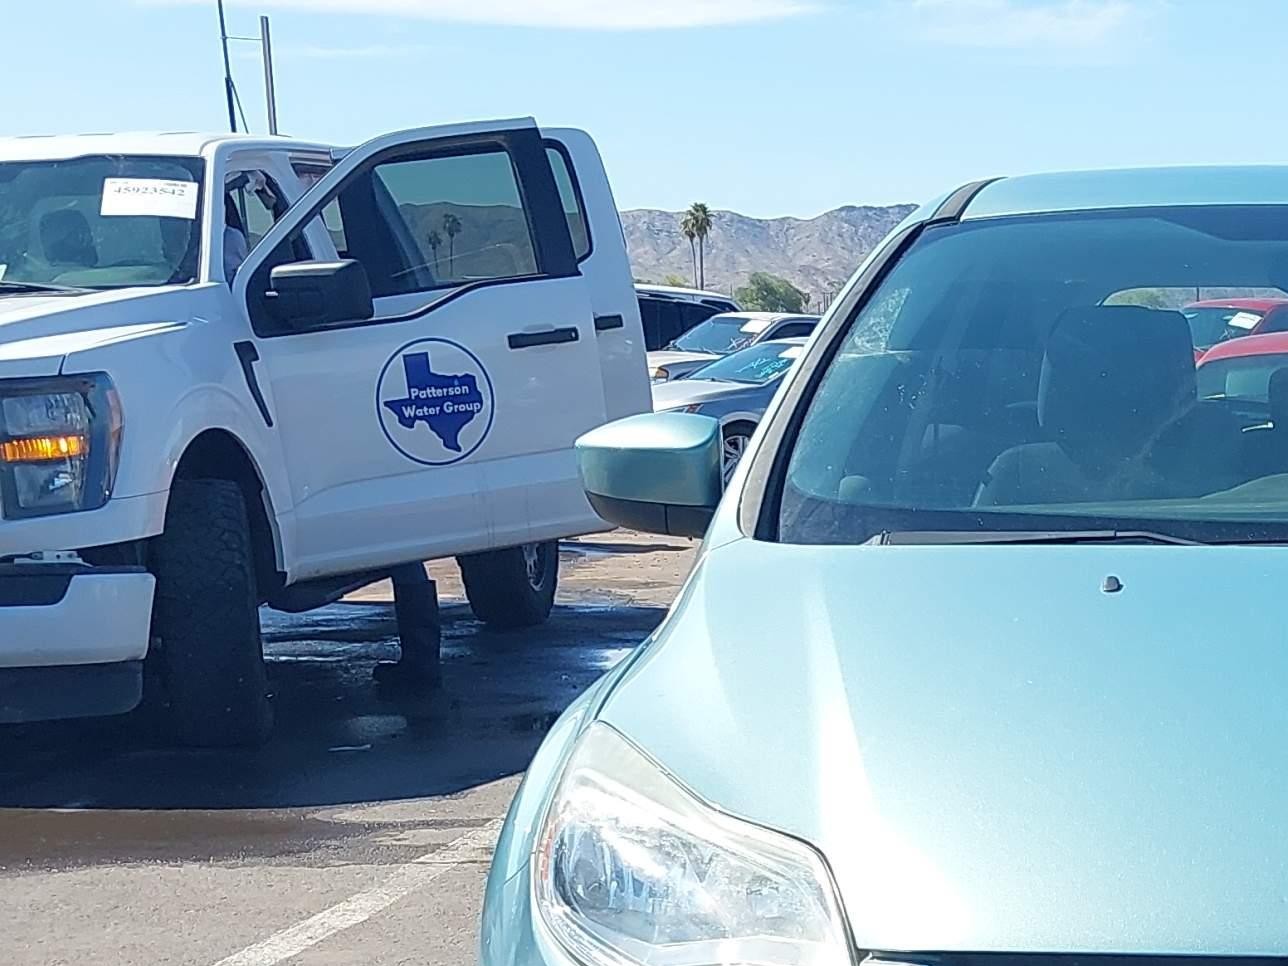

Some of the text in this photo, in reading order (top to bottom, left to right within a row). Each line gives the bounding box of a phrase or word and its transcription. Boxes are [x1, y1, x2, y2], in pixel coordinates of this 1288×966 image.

[410, 385, 469, 399] Patterson
[401, 401, 481, 418] Water Group
